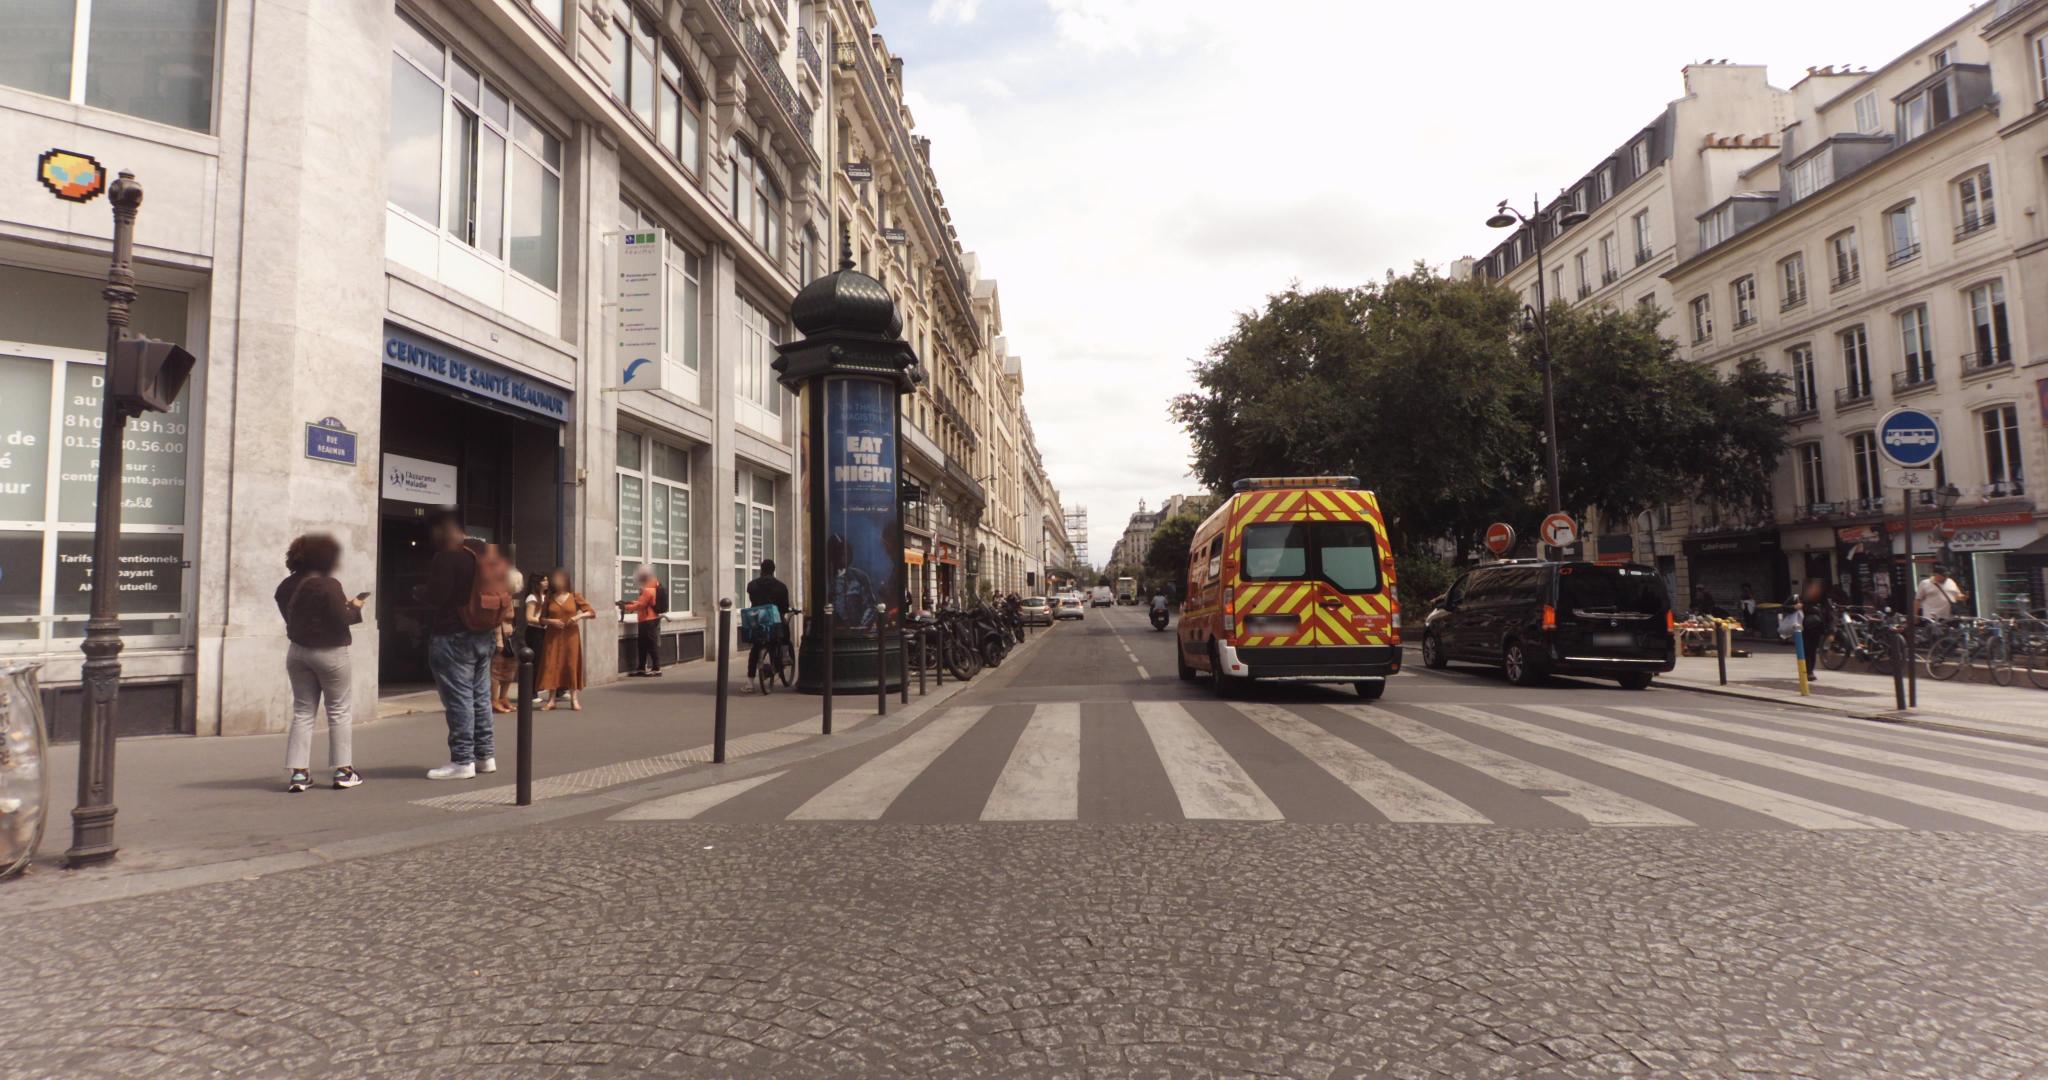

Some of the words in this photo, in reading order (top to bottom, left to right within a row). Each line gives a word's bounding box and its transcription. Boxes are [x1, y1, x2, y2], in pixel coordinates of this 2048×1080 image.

[386, 338, 446, 376] CENTRE
[450, 360, 467, 383] DE
[470, 367, 510, 397] SANTÉ
[511, 383, 563, 415] RÉAUMUR
[74, 397, 97, 407] au
[7, 430, 36, 446] de
[326, 435, 338, 445] RUE
[846, 436, 882, 453] EAT
[853, 454, 879, 465] THE
[125, 463, 148, 471] sur
[835, 466, 892, 483] NIGHT
[405, 479, 428, 489] Maladie
[60, 554, 93, 564] Tarifs
[118, 582, 158, 592] utuelle
